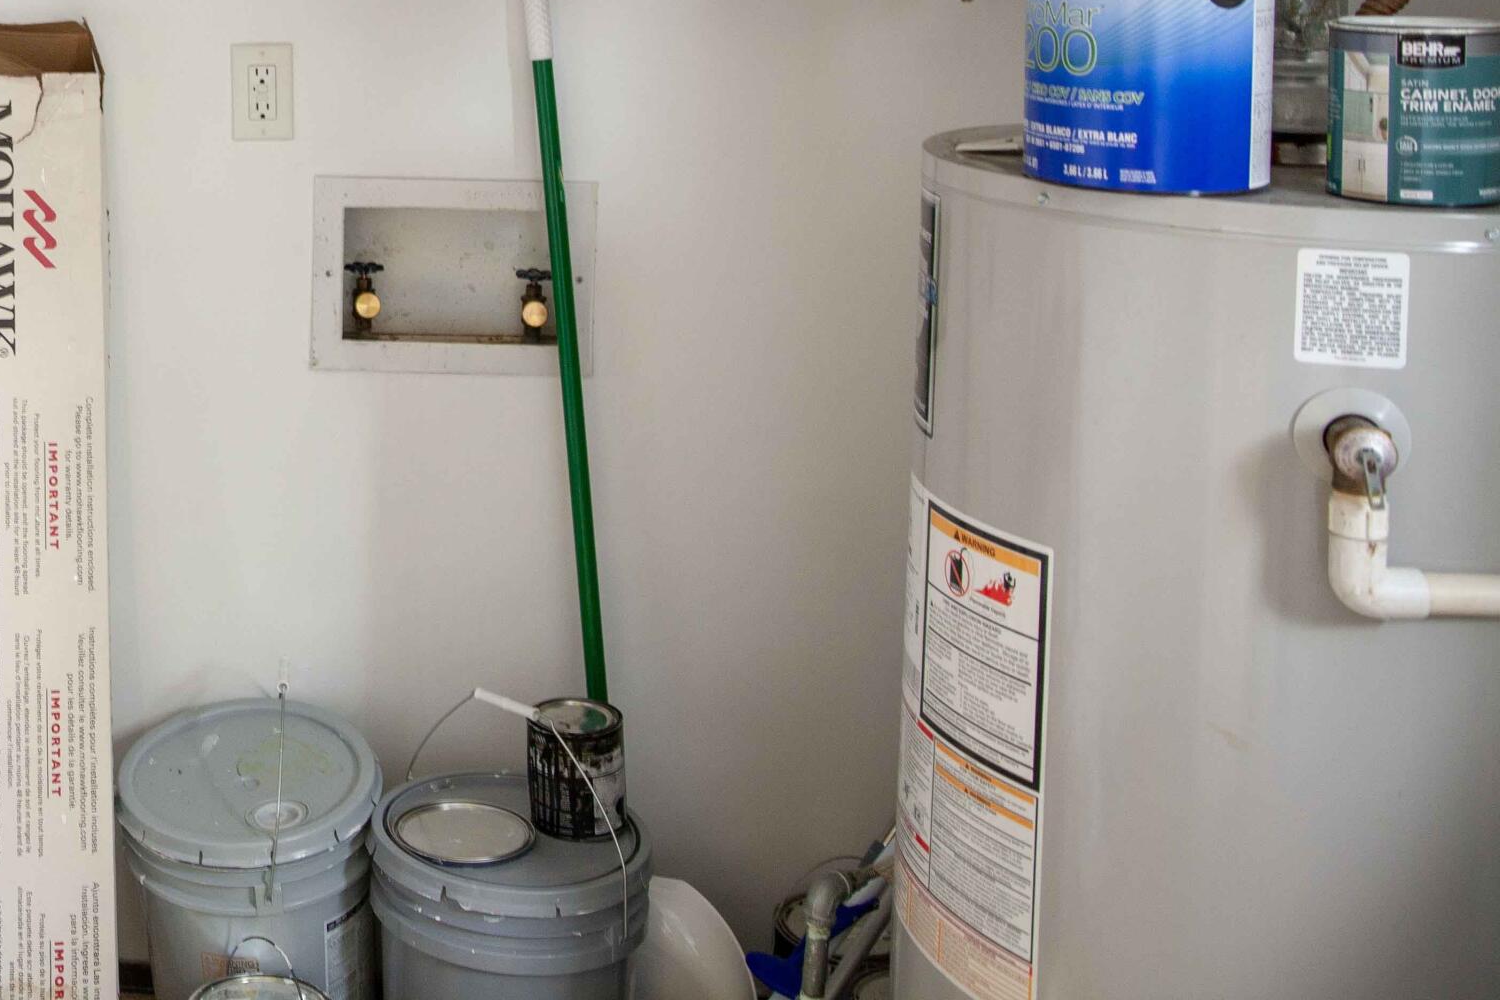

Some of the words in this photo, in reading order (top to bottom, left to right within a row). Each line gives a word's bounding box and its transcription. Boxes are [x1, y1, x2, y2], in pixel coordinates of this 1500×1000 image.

[1028, 0, 1099, 27] oMar
[1401, 41, 1444, 56] BEHR
[1401, 56, 1461, 65] PREMIUM
[1401, 79, 1429, 87] SATIN
[1400, 88, 1469, 101] CABINET,
[1400, 100, 1439, 113] TRIM
[1443, 100, 1496, 112] ENAMEL
[1046, 123, 1070, 137] BLANCO
[1078, 128, 1105, 142] EXTRA
[1107, 131, 1138, 145] BLANC
[75, 405, 83, 435] Please
[74, 436, 82, 449] go
[75, 450, 82, 461] to
[49, 442, 59, 549] IMPORTANT
[961, 533, 996, 558] WARNING
[51, 690, 61, 796] IMPORTANT
